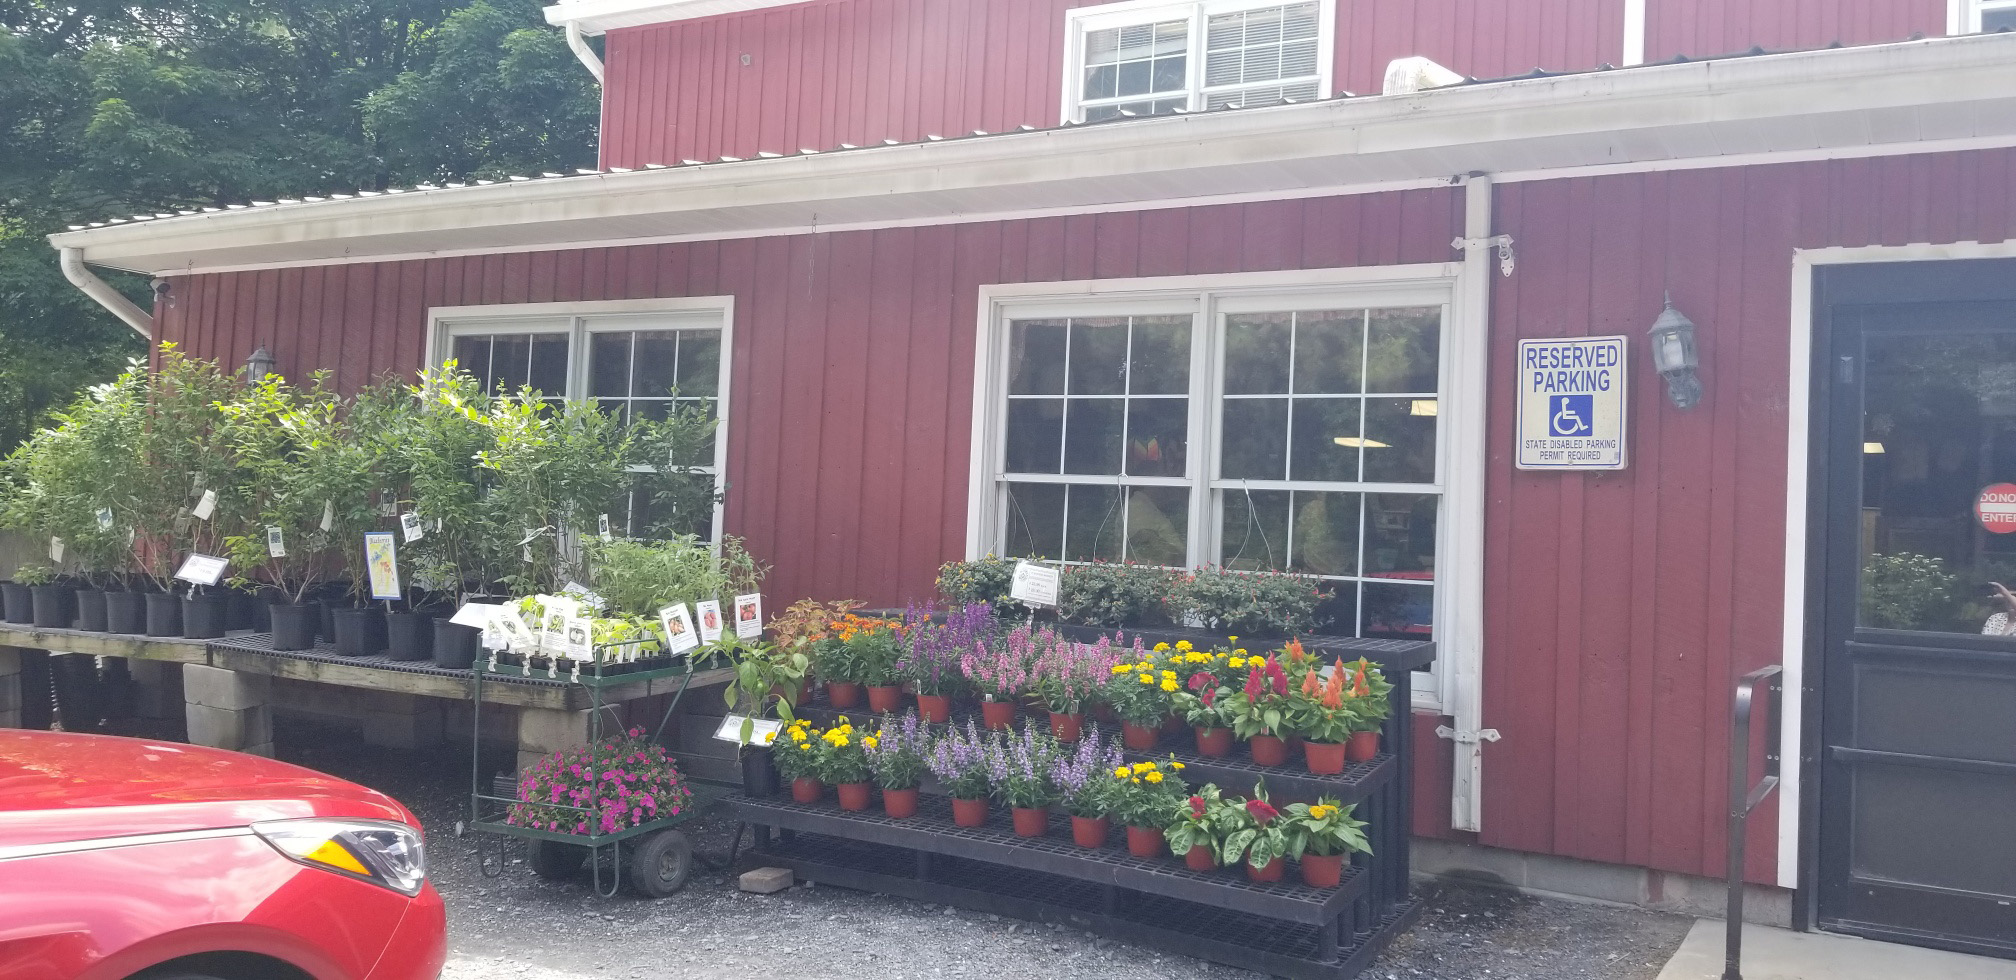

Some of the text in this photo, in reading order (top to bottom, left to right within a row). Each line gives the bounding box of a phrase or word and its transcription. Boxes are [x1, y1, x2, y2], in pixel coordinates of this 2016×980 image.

[1526, 345, 1618, 369] RESERVED
[1533, 369, 1610, 393] PARKING
[1525, 439, 1616, 449] STATE DISABLED PARKING
[1539, 450, 1601, 460] PERMIT REQUIRED
[1980, 493, 2016, 503] DO NO
